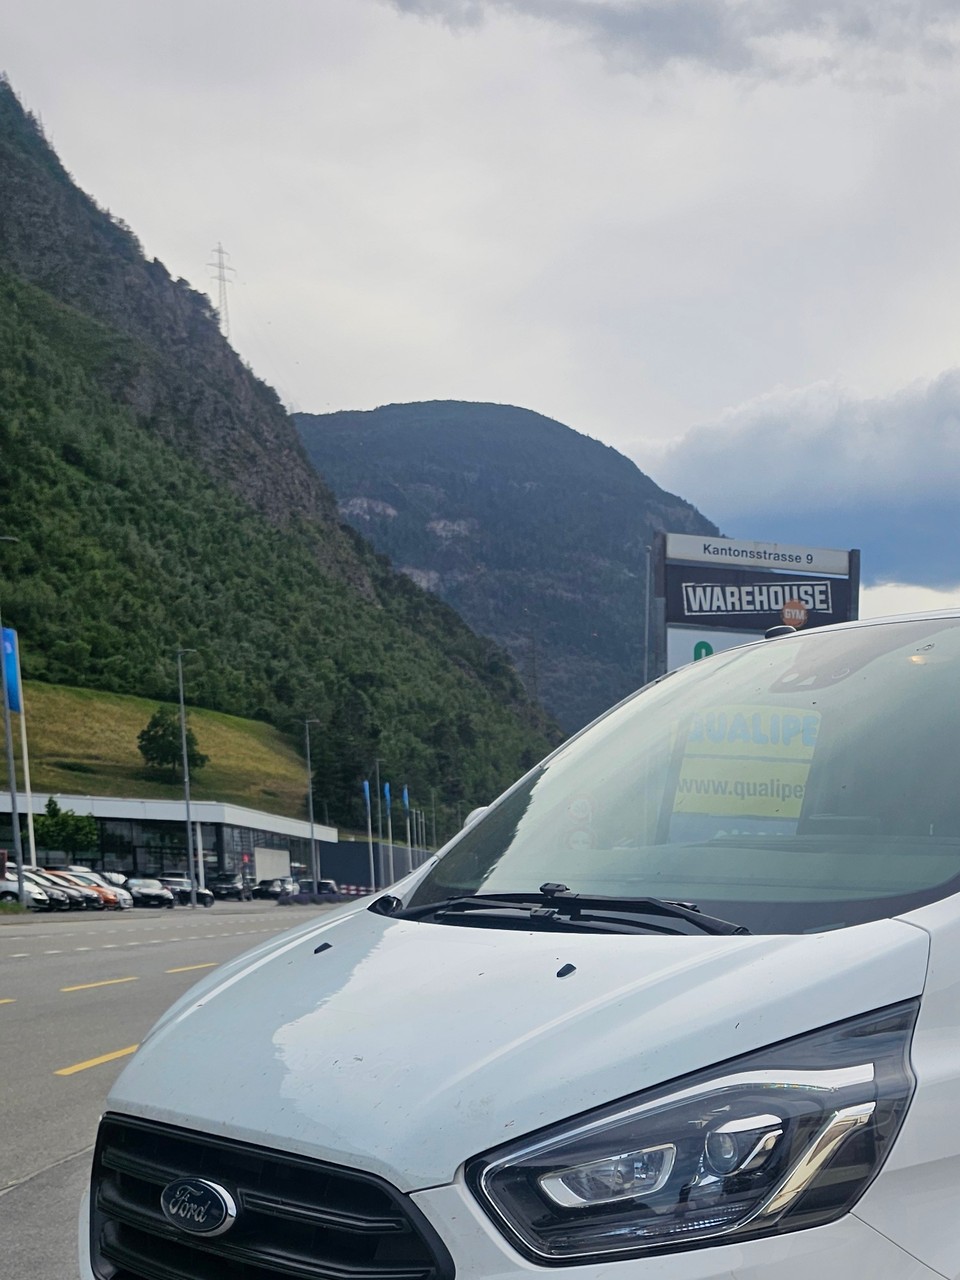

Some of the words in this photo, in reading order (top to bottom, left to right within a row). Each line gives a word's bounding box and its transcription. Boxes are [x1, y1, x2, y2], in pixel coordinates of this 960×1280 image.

[703, 543, 802, 563] Kantonsstrasse
[806, 553, 814, 565] 9
[686, 584, 828, 611] WAREHOUSE
[783, 607, 805, 621] GYM
[677, 778, 807, 802] www.qualipe
[169, 1185, 212, 1223] Ford
